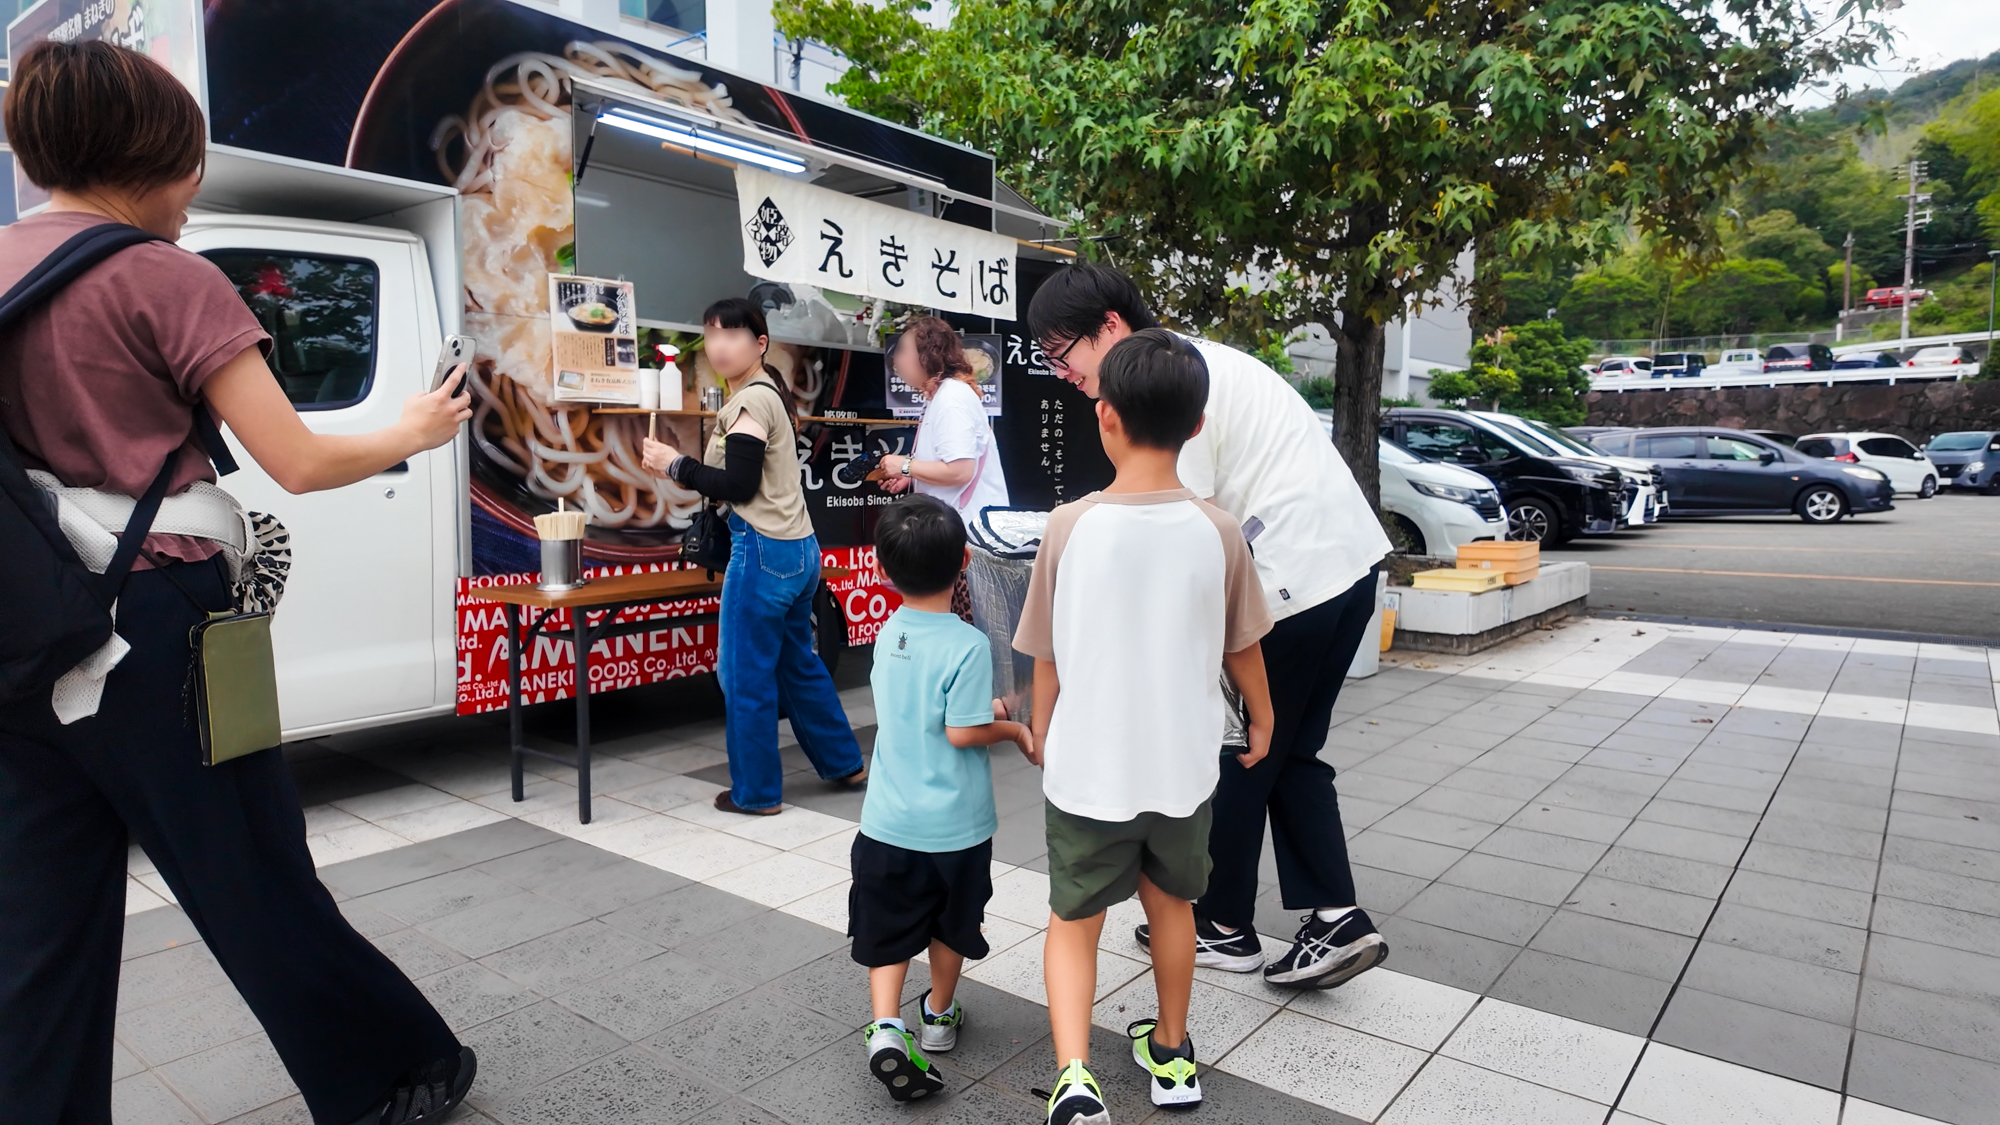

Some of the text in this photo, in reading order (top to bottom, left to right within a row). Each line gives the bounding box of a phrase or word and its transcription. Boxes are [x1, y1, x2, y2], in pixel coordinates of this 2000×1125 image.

[818, 218, 1009, 306] えきそば
[1041, 399, 1051, 475] ありません。
[826, 494, 864, 507] Ekisoba
[867, 494, 892, 506] Since
[458, 687, 498, 703] o.,Ltd.
[588, 659, 638, 682] OODS
[644, 650, 701, 673] Co.,Ltd.
